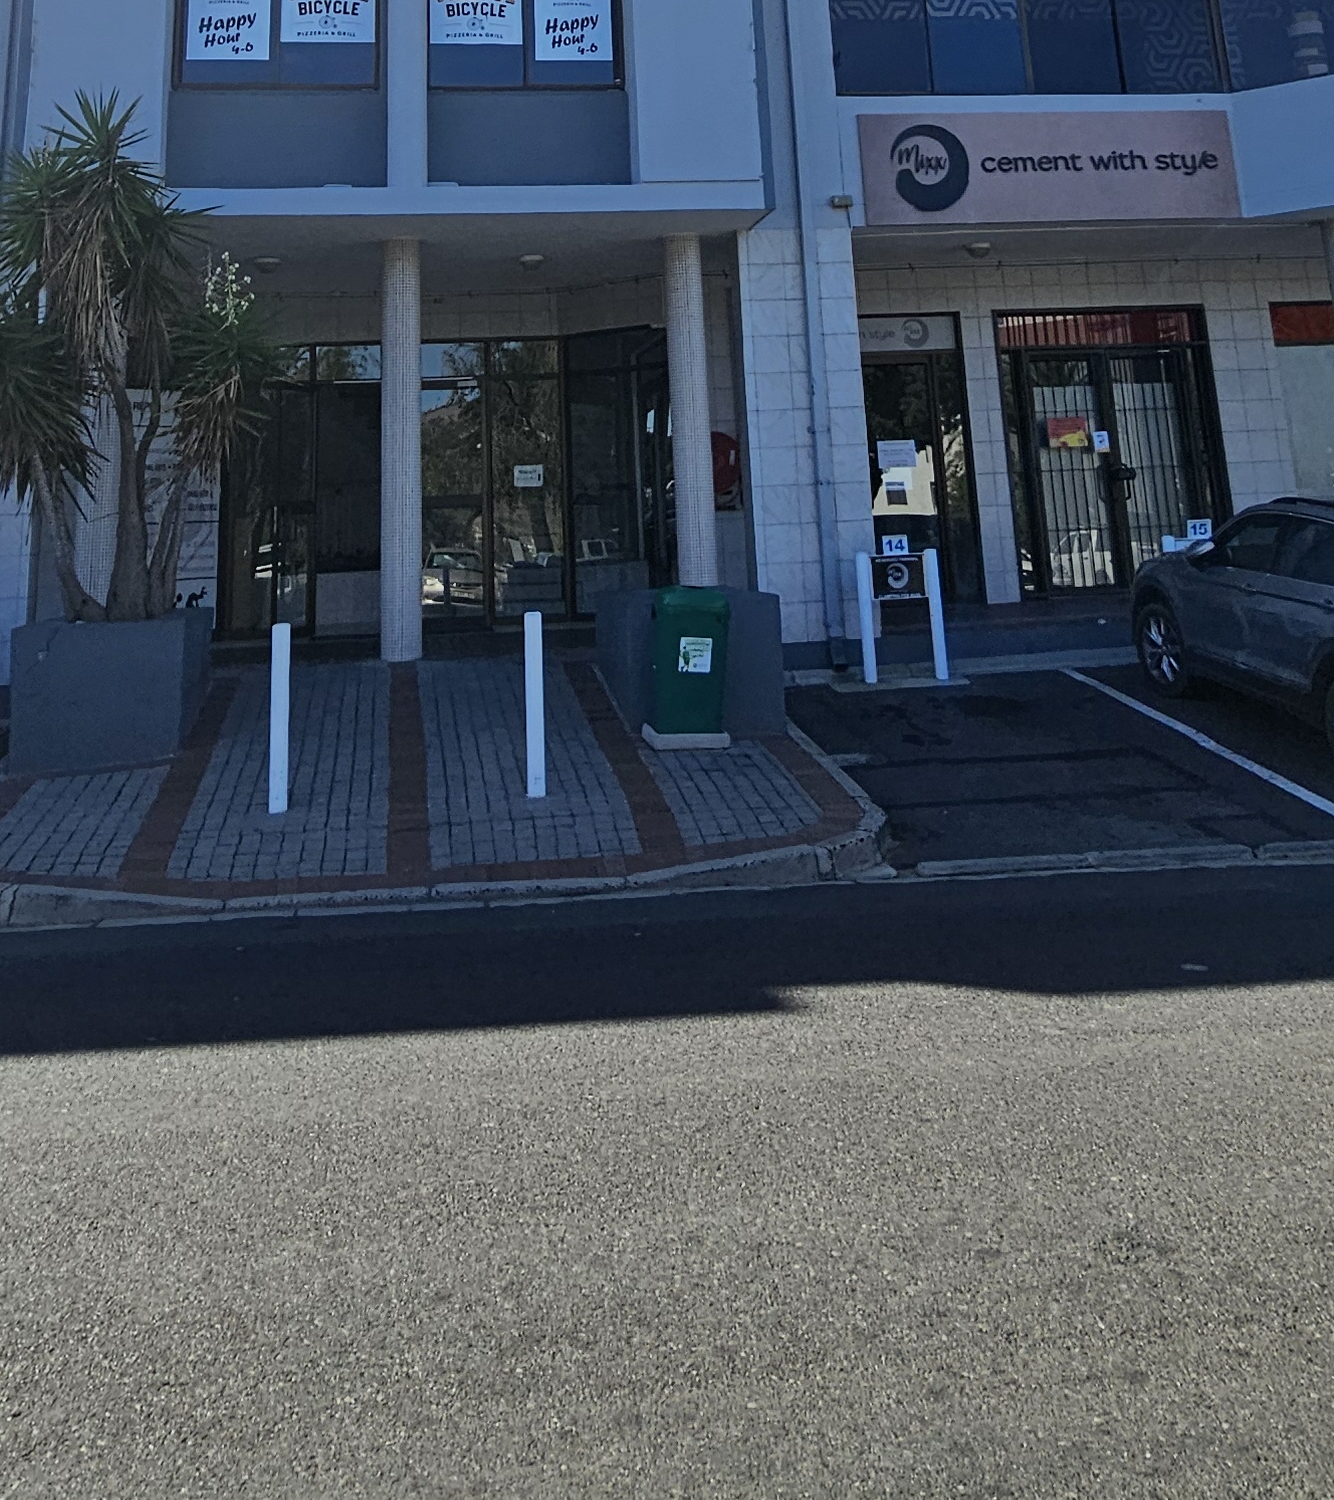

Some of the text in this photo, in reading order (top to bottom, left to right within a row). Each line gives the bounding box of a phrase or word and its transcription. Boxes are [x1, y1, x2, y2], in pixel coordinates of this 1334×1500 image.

[298, 0, 361, 16] BICYCLE
[445, 2, 507, 18] BICYCLE
[198, 12, 256, 34] Happy
[545, 14, 599, 35] Happy
[204, 32, 240, 48] Hour
[551, 34, 585, 49] Hour
[980, 153, 1083, 173] cement
[1089, 150, 1148, 172] with
[1190, 523, 1208, 536] 15
[885, 538, 906, 552] 14
